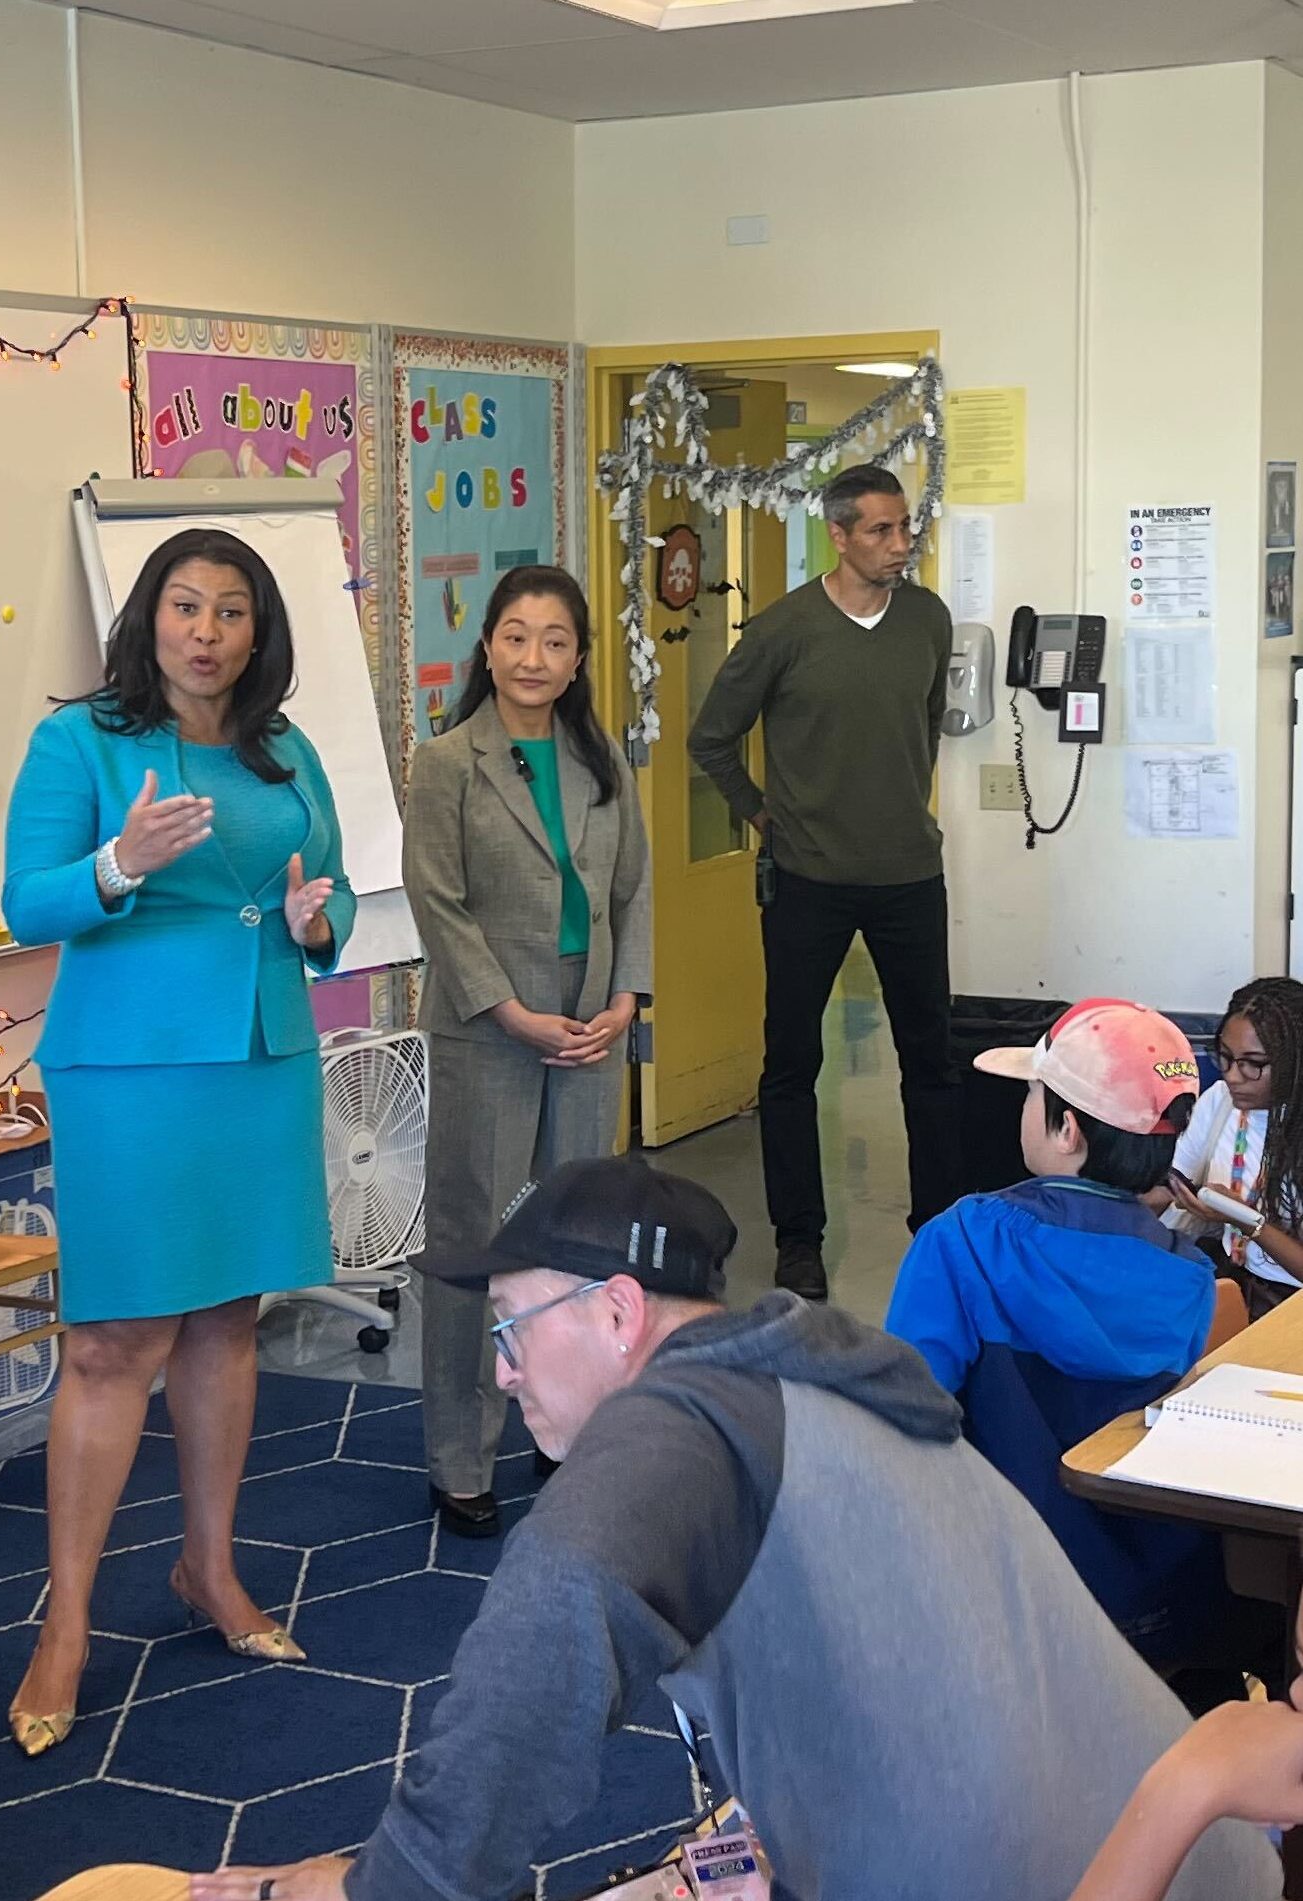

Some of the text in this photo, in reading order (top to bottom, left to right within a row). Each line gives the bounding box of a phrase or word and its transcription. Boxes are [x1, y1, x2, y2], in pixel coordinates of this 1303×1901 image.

[154, 382, 356, 450] all about us
[411, 384, 497, 445] CLASS
[425, 466, 528, 514] JOBS
[1130, 506, 1211, 519] IN AN EMERGENCY
